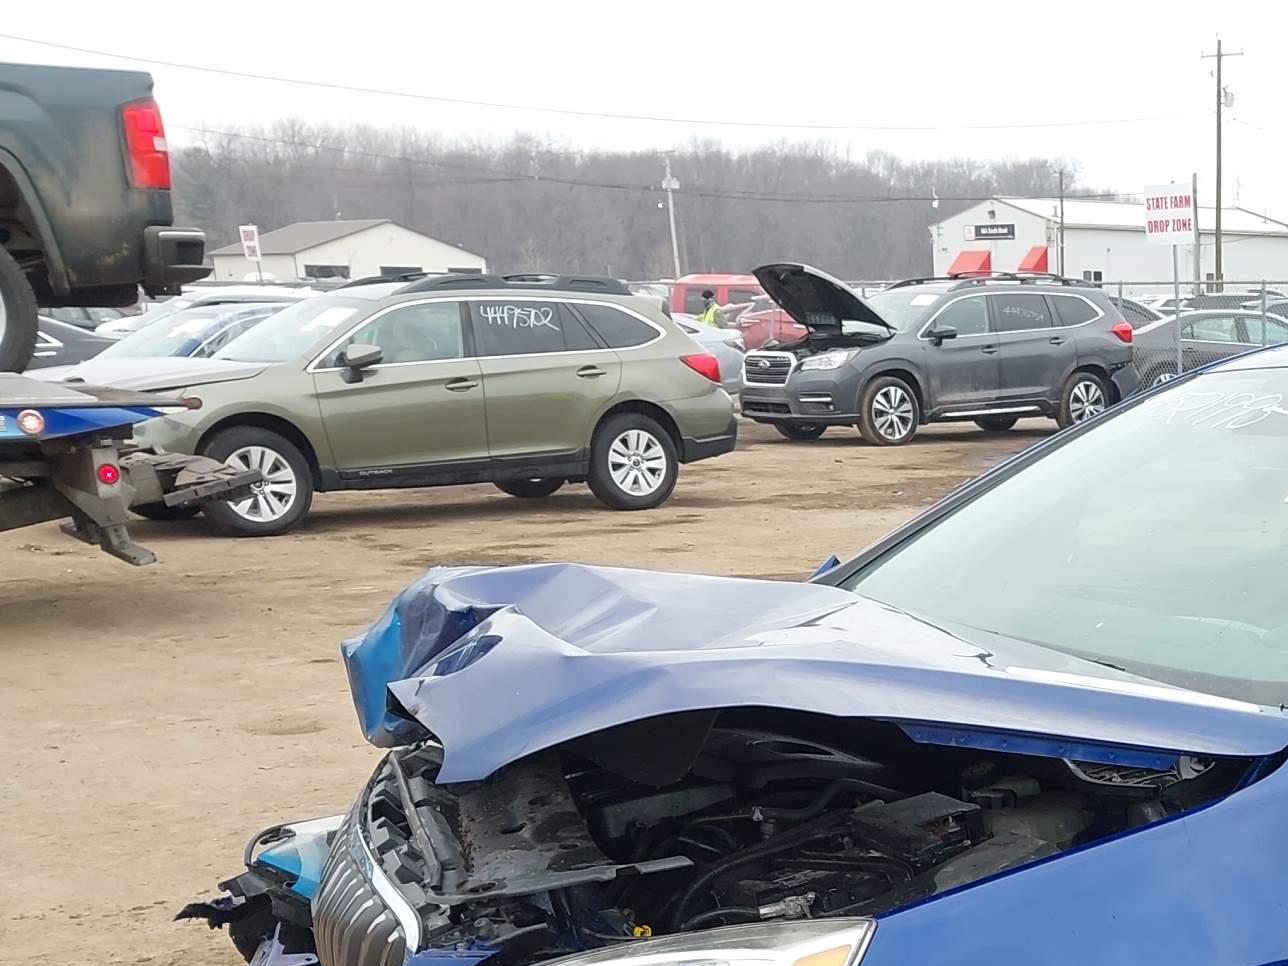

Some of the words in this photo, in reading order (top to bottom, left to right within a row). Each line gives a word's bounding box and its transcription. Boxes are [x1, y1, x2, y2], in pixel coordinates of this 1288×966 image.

[1146, 196, 1168, 211] STATE
[1170, 194, 1191, 209] FARM
[1147, 219, 1170, 234] DROP
[1172, 218, 1192, 232] ZONE
